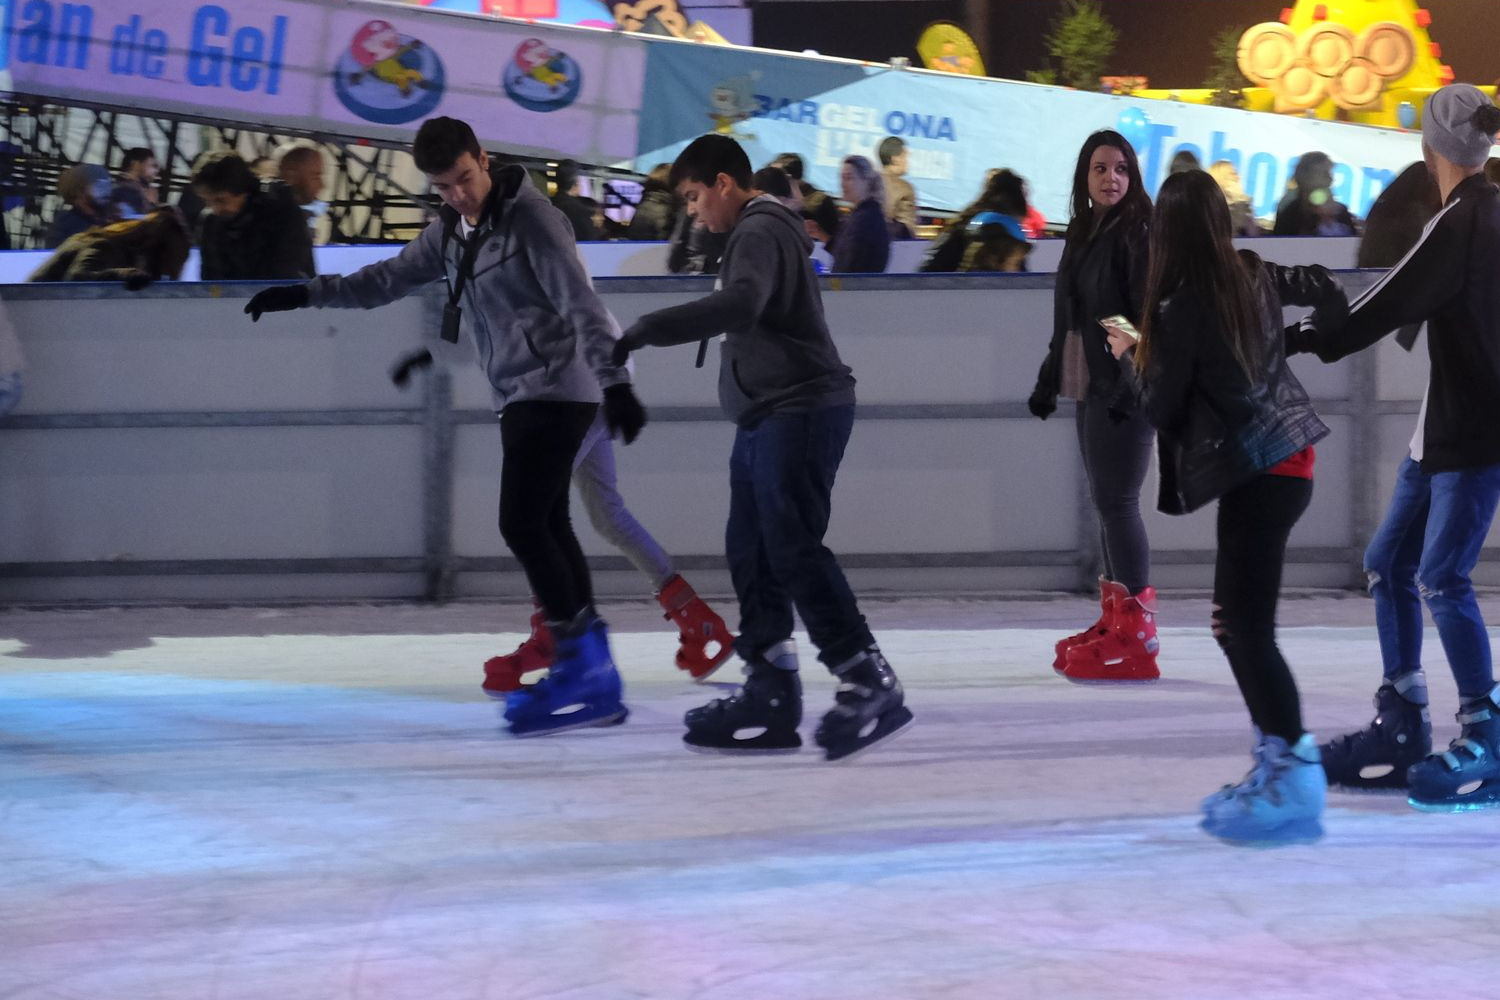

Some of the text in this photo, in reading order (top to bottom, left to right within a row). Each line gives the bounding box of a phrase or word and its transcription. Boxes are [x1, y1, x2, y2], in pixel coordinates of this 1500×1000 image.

[109, 14, 168, 78] de
[187, 4, 289, 95] Gel
[751, 93, 958, 142] BARGELONA
